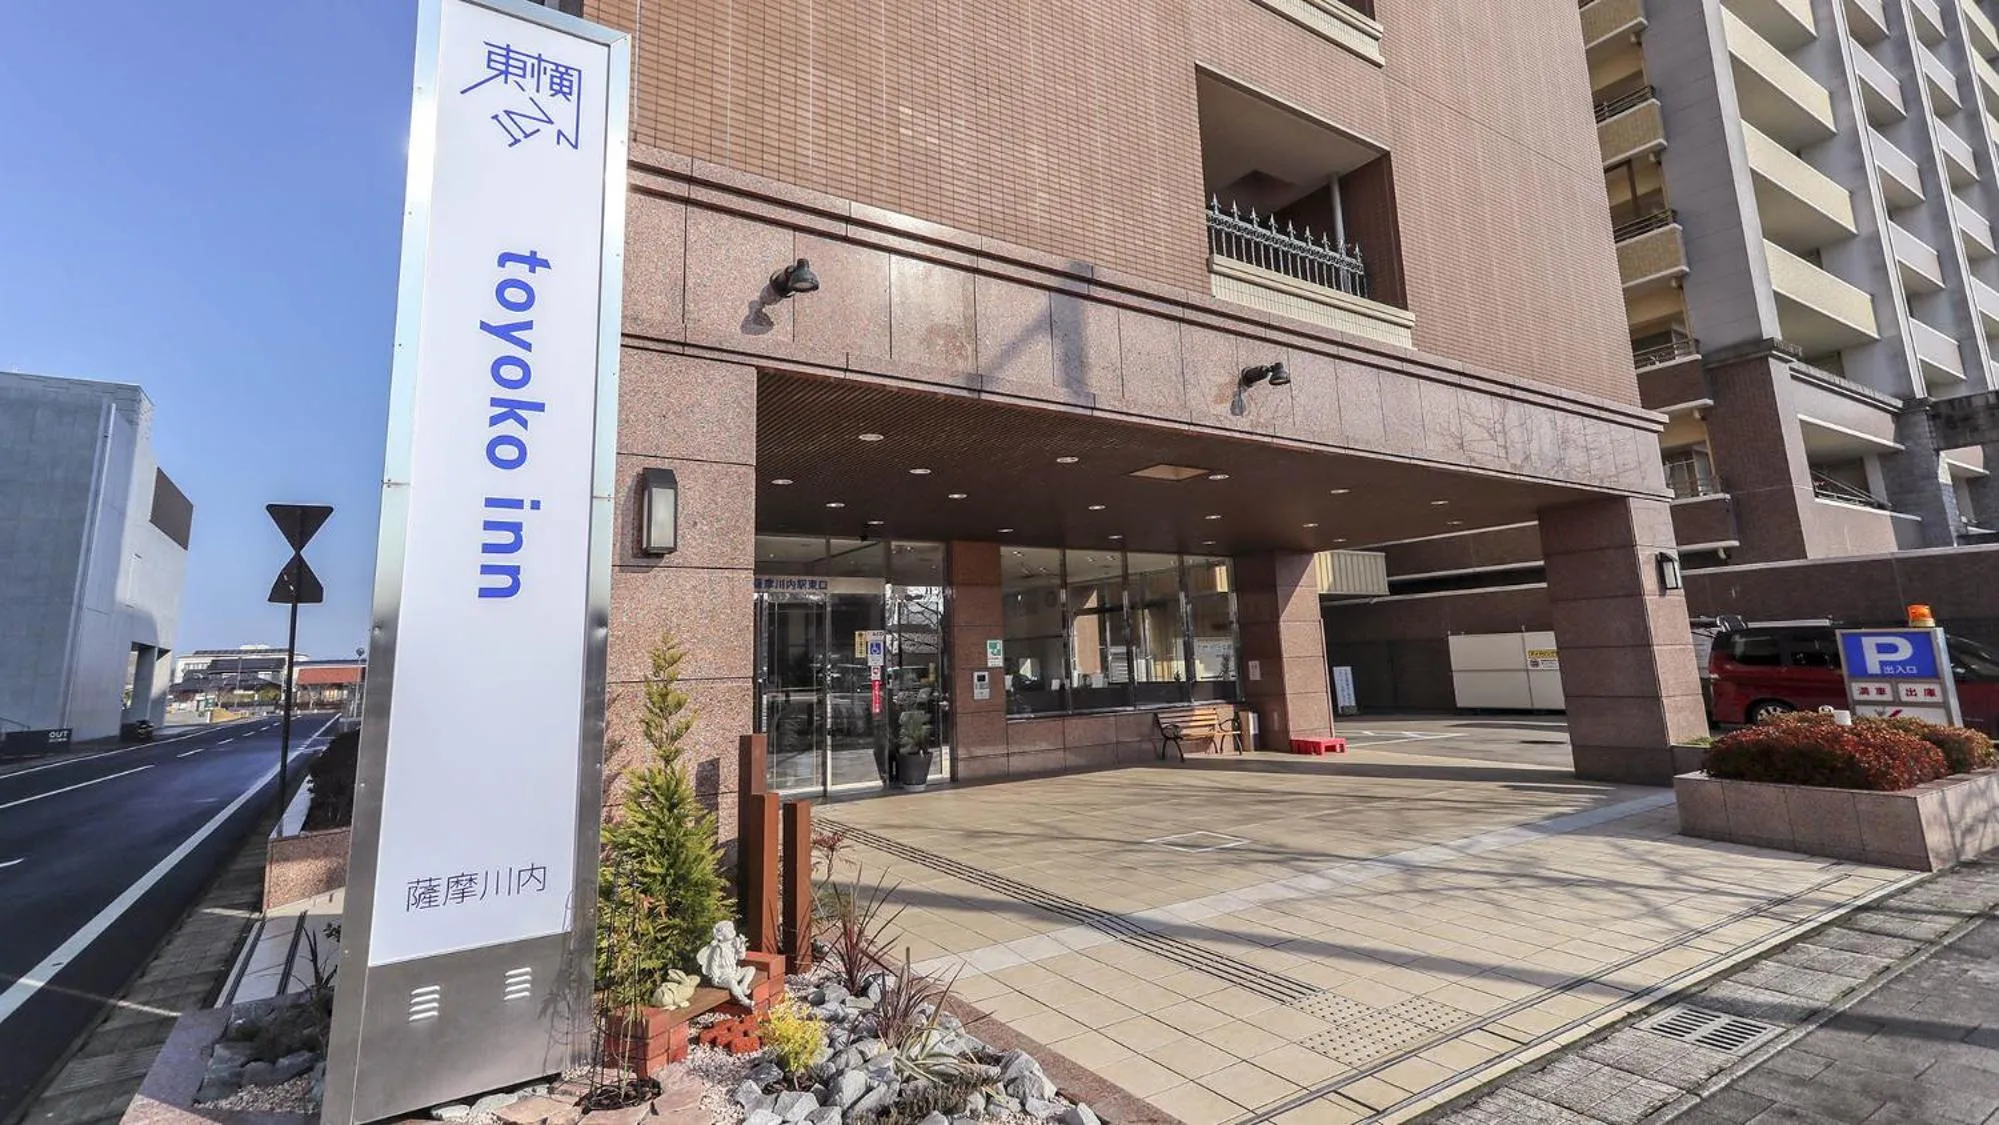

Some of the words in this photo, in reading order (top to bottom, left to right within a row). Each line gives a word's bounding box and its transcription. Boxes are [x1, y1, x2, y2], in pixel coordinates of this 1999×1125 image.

[479, 250, 552, 470] toyoko
[478, 497, 541, 599] inn
[1861, 636, 1914, 674] P
[1883, 665, 1918, 674] 出入口
[1905, 688, 1937, 698] 出庫
[406, 862, 547, 912] 薩摩川内
